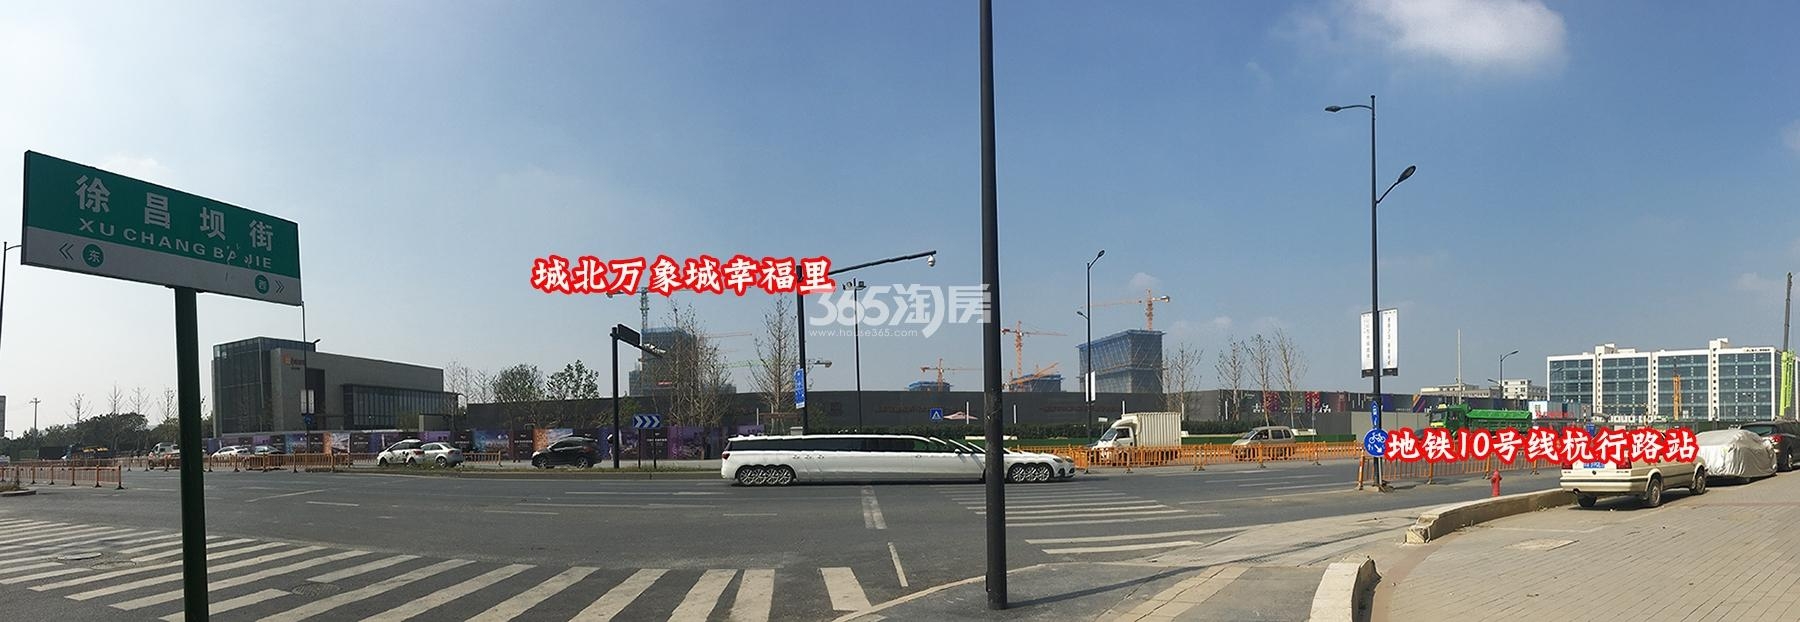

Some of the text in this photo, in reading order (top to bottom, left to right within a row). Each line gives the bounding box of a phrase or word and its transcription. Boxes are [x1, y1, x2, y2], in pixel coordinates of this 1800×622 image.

[75, 174, 274, 252] 徐昌坝街
[80, 218, 114, 236] XU
[123, 228, 206, 256] CHANG
[88, 250, 101, 263] 东
